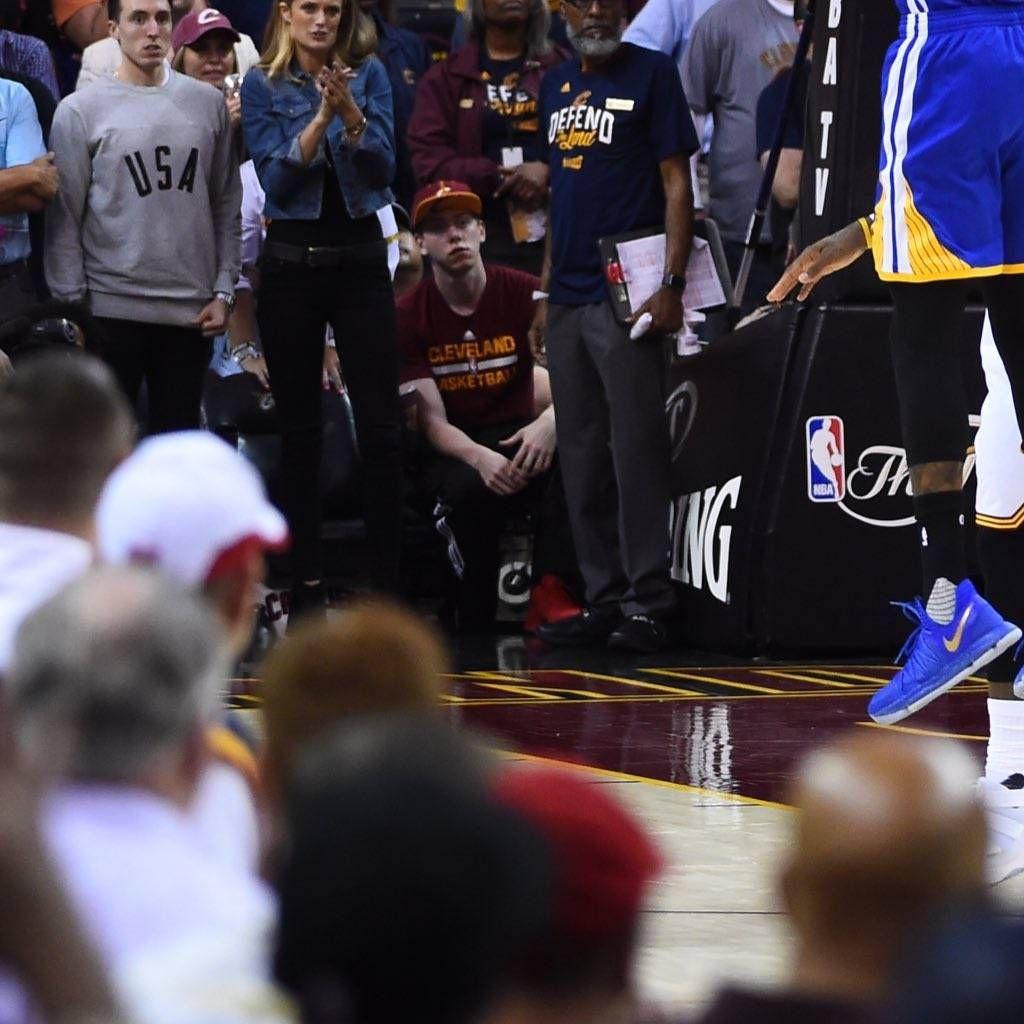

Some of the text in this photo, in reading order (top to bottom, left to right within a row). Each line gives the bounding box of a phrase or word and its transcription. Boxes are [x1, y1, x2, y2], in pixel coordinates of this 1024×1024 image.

[549, 104, 615, 145] DEFEND
[124, 145, 199, 198] USA
[427, 333, 517, 364] CLEVELAND
[813, 483, 833, 498] NBA
